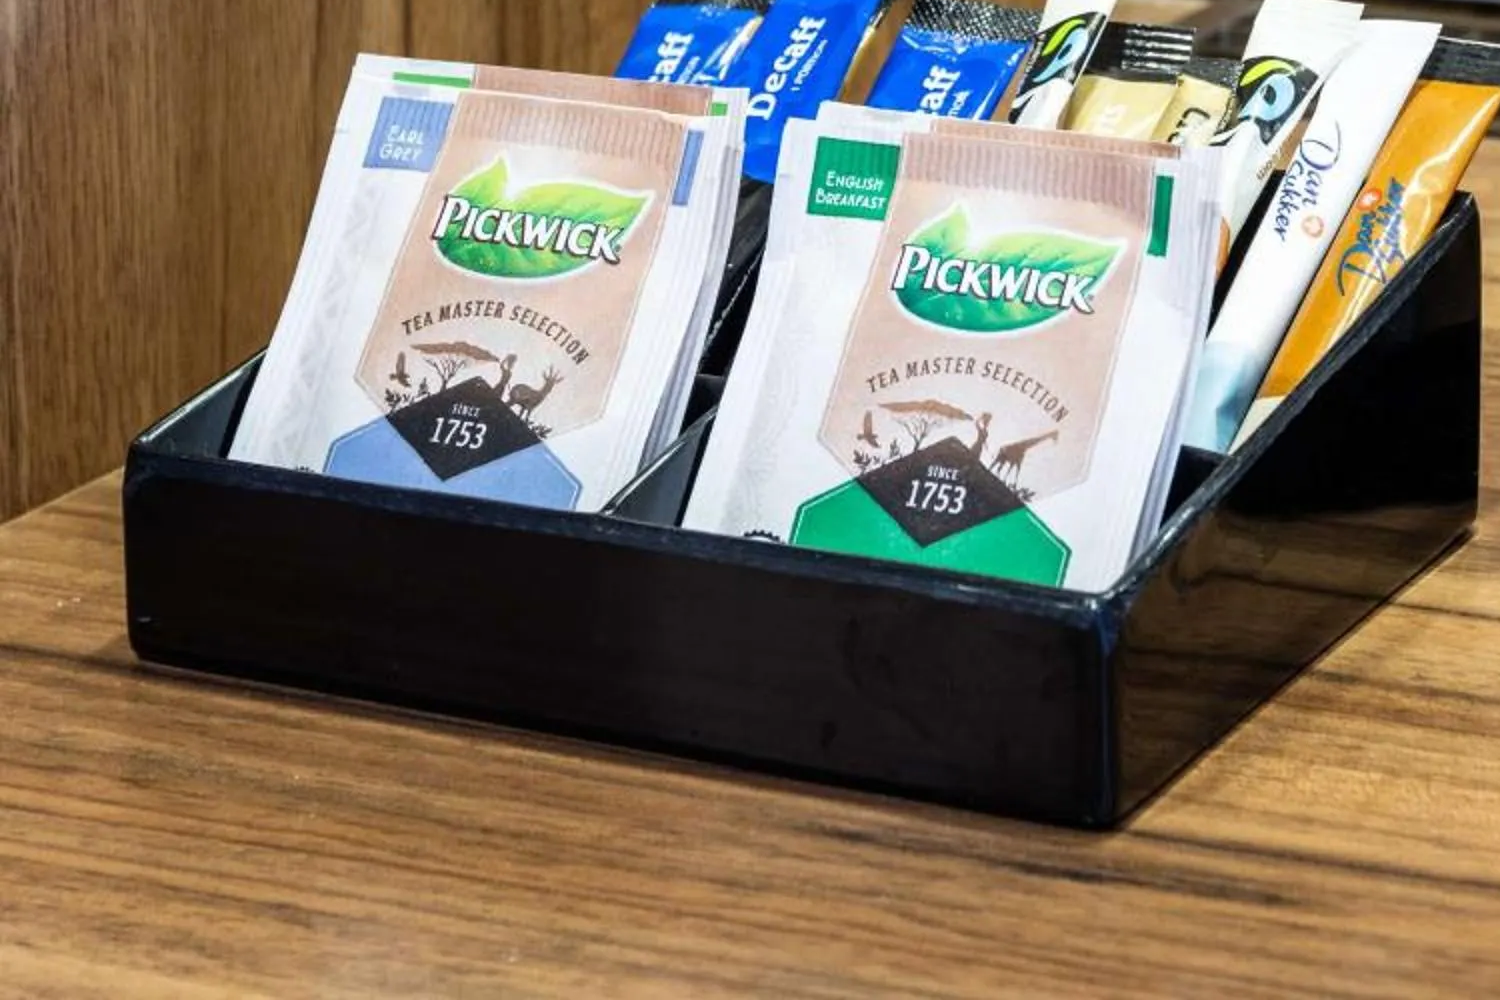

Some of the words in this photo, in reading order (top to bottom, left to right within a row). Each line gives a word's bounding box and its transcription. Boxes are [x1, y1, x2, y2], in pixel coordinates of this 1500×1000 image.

[648, 31, 695, 83] aff
[917, 65, 961, 117] aff
[387, 124, 424, 145] EARL
[379, 143, 423, 162] GREY
[825, 169, 885, 191] ENGLISH
[815, 187, 886, 210] BREAKFAST
[431, 194, 623, 266] PICKWICK
[890, 243, 1095, 315] PICKWICK
[401, 310, 434, 336] TEA
[438, 298, 506, 323] MASTER
[509, 304, 591, 366] SELECTION
[866, 367, 900, 394] TEA
[905, 356, 977, 380] MASTER
[981, 360, 1070, 424] SELECTION
[451, 402, 481, 418] SINCE
[429, 416, 488, 450] 1753
[927, 464, 959, 481] SINCE
[904, 479, 968, 515] 1753
